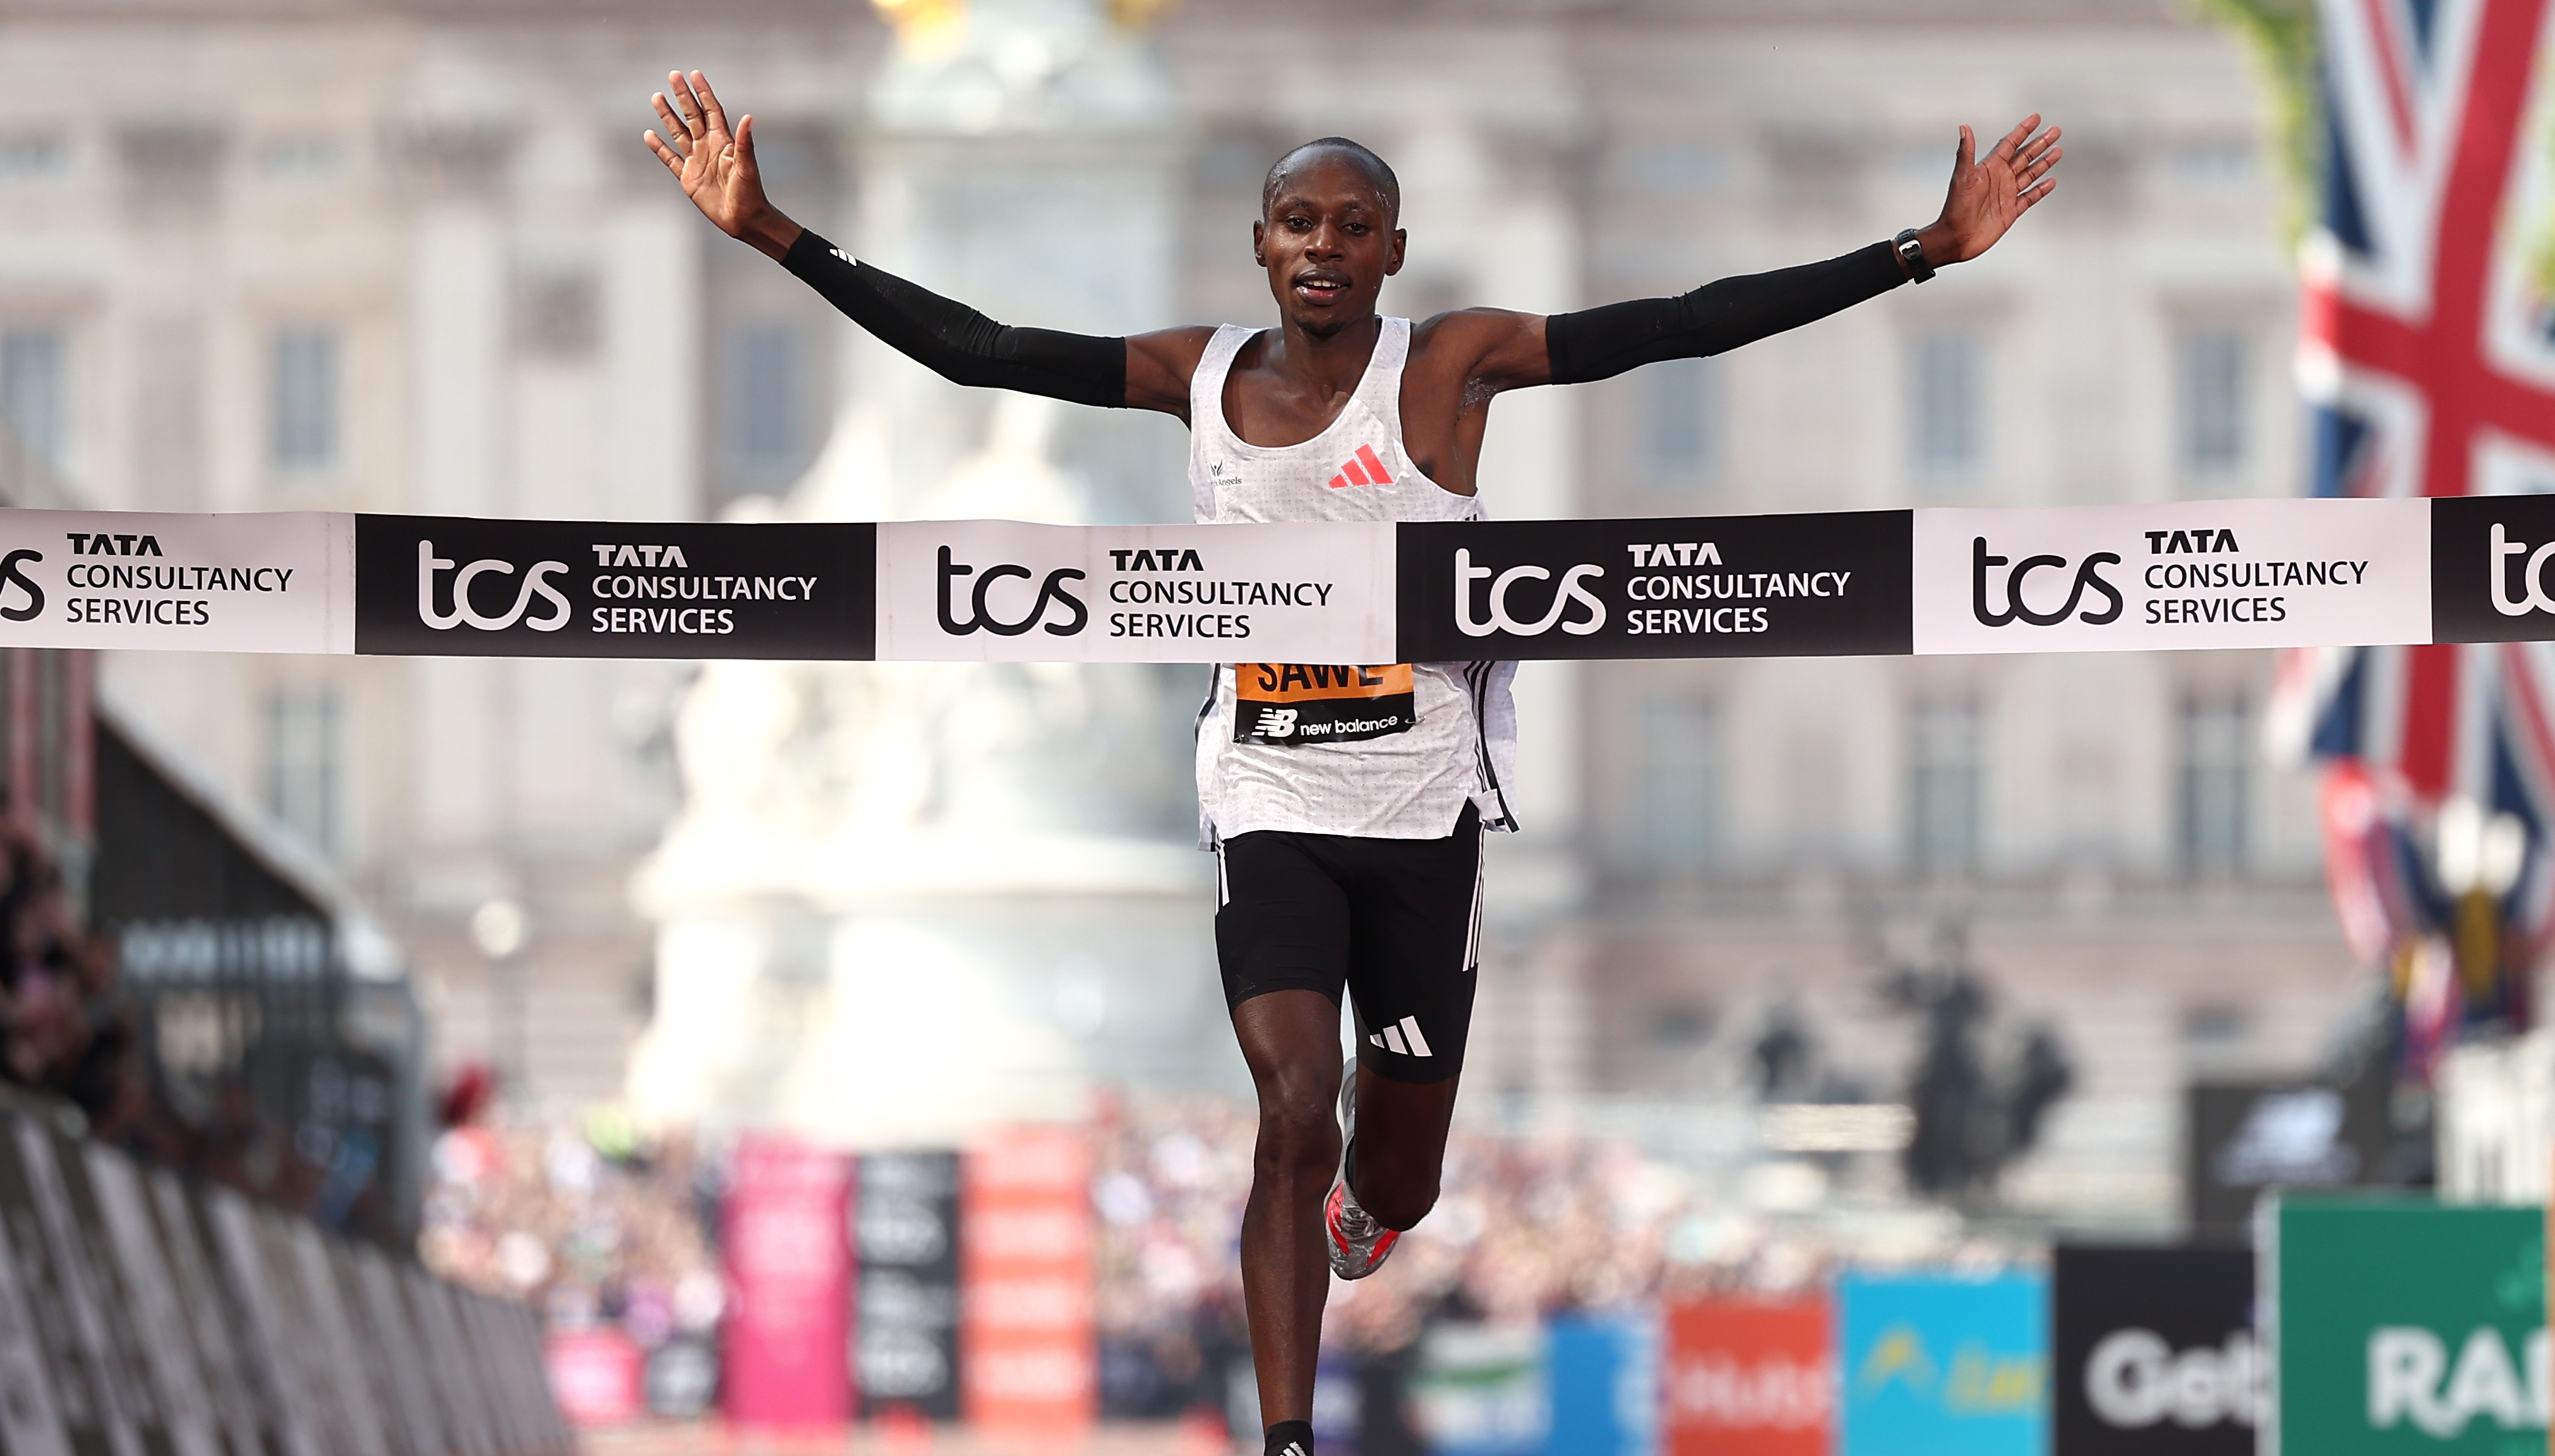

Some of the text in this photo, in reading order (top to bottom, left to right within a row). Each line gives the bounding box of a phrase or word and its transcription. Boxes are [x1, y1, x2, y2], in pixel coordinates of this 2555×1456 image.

[66, 533, 163, 557] TATA
[1627, 542, 1723, 567] TATA
[2144, 529, 2240, 555] TATA
[592, 544, 688, 568] TATA
[1109, 549, 1204, 572] TATA
[67, 564, 294, 592] CONSULTANCY
[419, 539, 572, 632] tcs
[592, 575, 817, 601] CONSULTANCY
[1627, 572, 1851, 601] CONSULTANCY
[1973, 536, 2124, 627] tcs
[2144, 560, 2369, 589] CONSULTANCY
[937, 545, 1088, 637] tcs
[1110, 580, 1333, 606] CONSULTANCY
[1455, 548, 1606, 637] tcs
[66, 598, 210, 625] SERVICES
[592, 607, 734, 634] SERVICES
[1627, 607, 1769, 634] SERVICES
[2145, 596, 2286, 625] SERVICES
[1110, 613, 1251, 639] SERVICES
[1299, 715, 1398, 737] new balance
